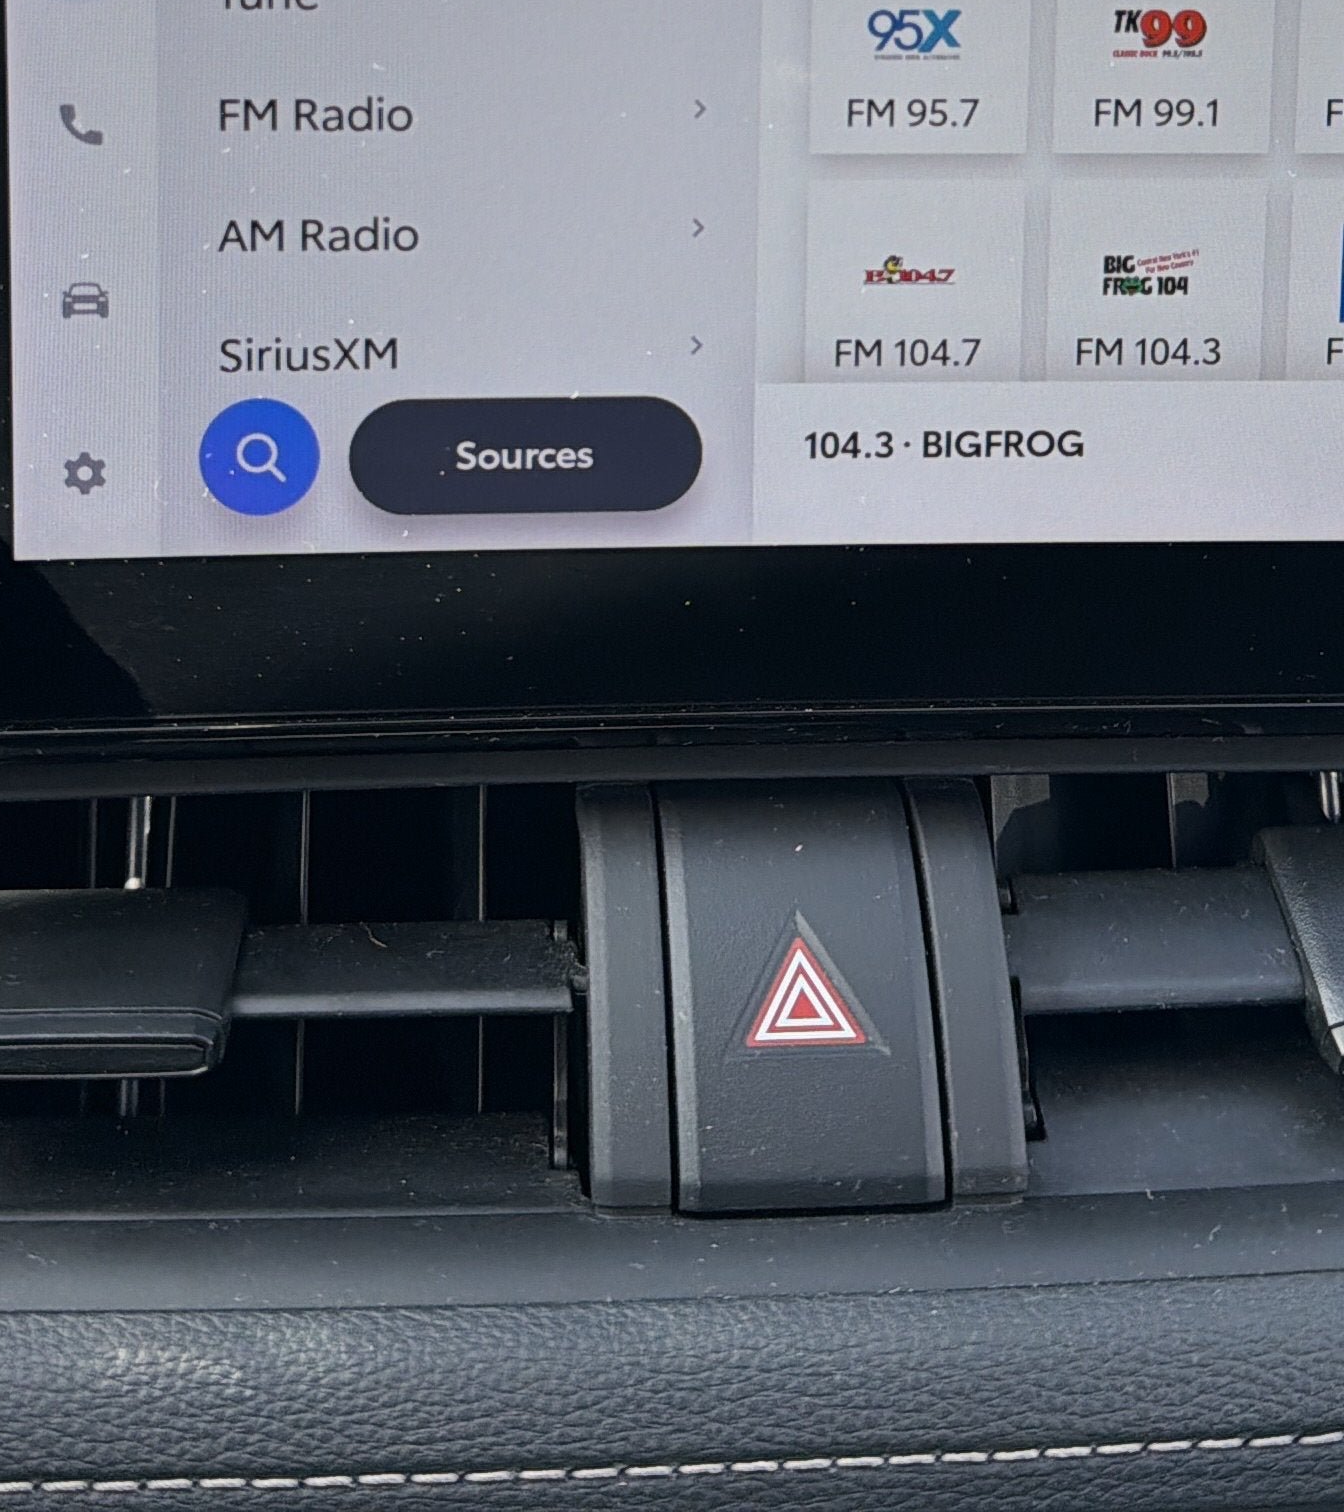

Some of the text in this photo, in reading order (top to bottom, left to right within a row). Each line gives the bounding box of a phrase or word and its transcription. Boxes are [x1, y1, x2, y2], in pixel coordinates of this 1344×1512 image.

[868, 9, 962, 53] 95X
[219, 95, 413, 132] FM Radio
[847, 98, 980, 128] FM 95.7
[1094, 98, 1219, 127] FM 99.1
[218, 216, 420, 253] AM Radio
[1103, 254, 1136, 275] BIG
[1102, 275, 1189, 296] FRG 104
[219, 336, 399, 374] SiriusXM
[835, 338, 982, 368] FM 104.7
[1075, 337, 1222, 367] FM 104.3
[455, 439, 595, 472] Sources
[804, 430, 895, 460] 104.3
[921, 429, 1085, 459] BIGFROG
